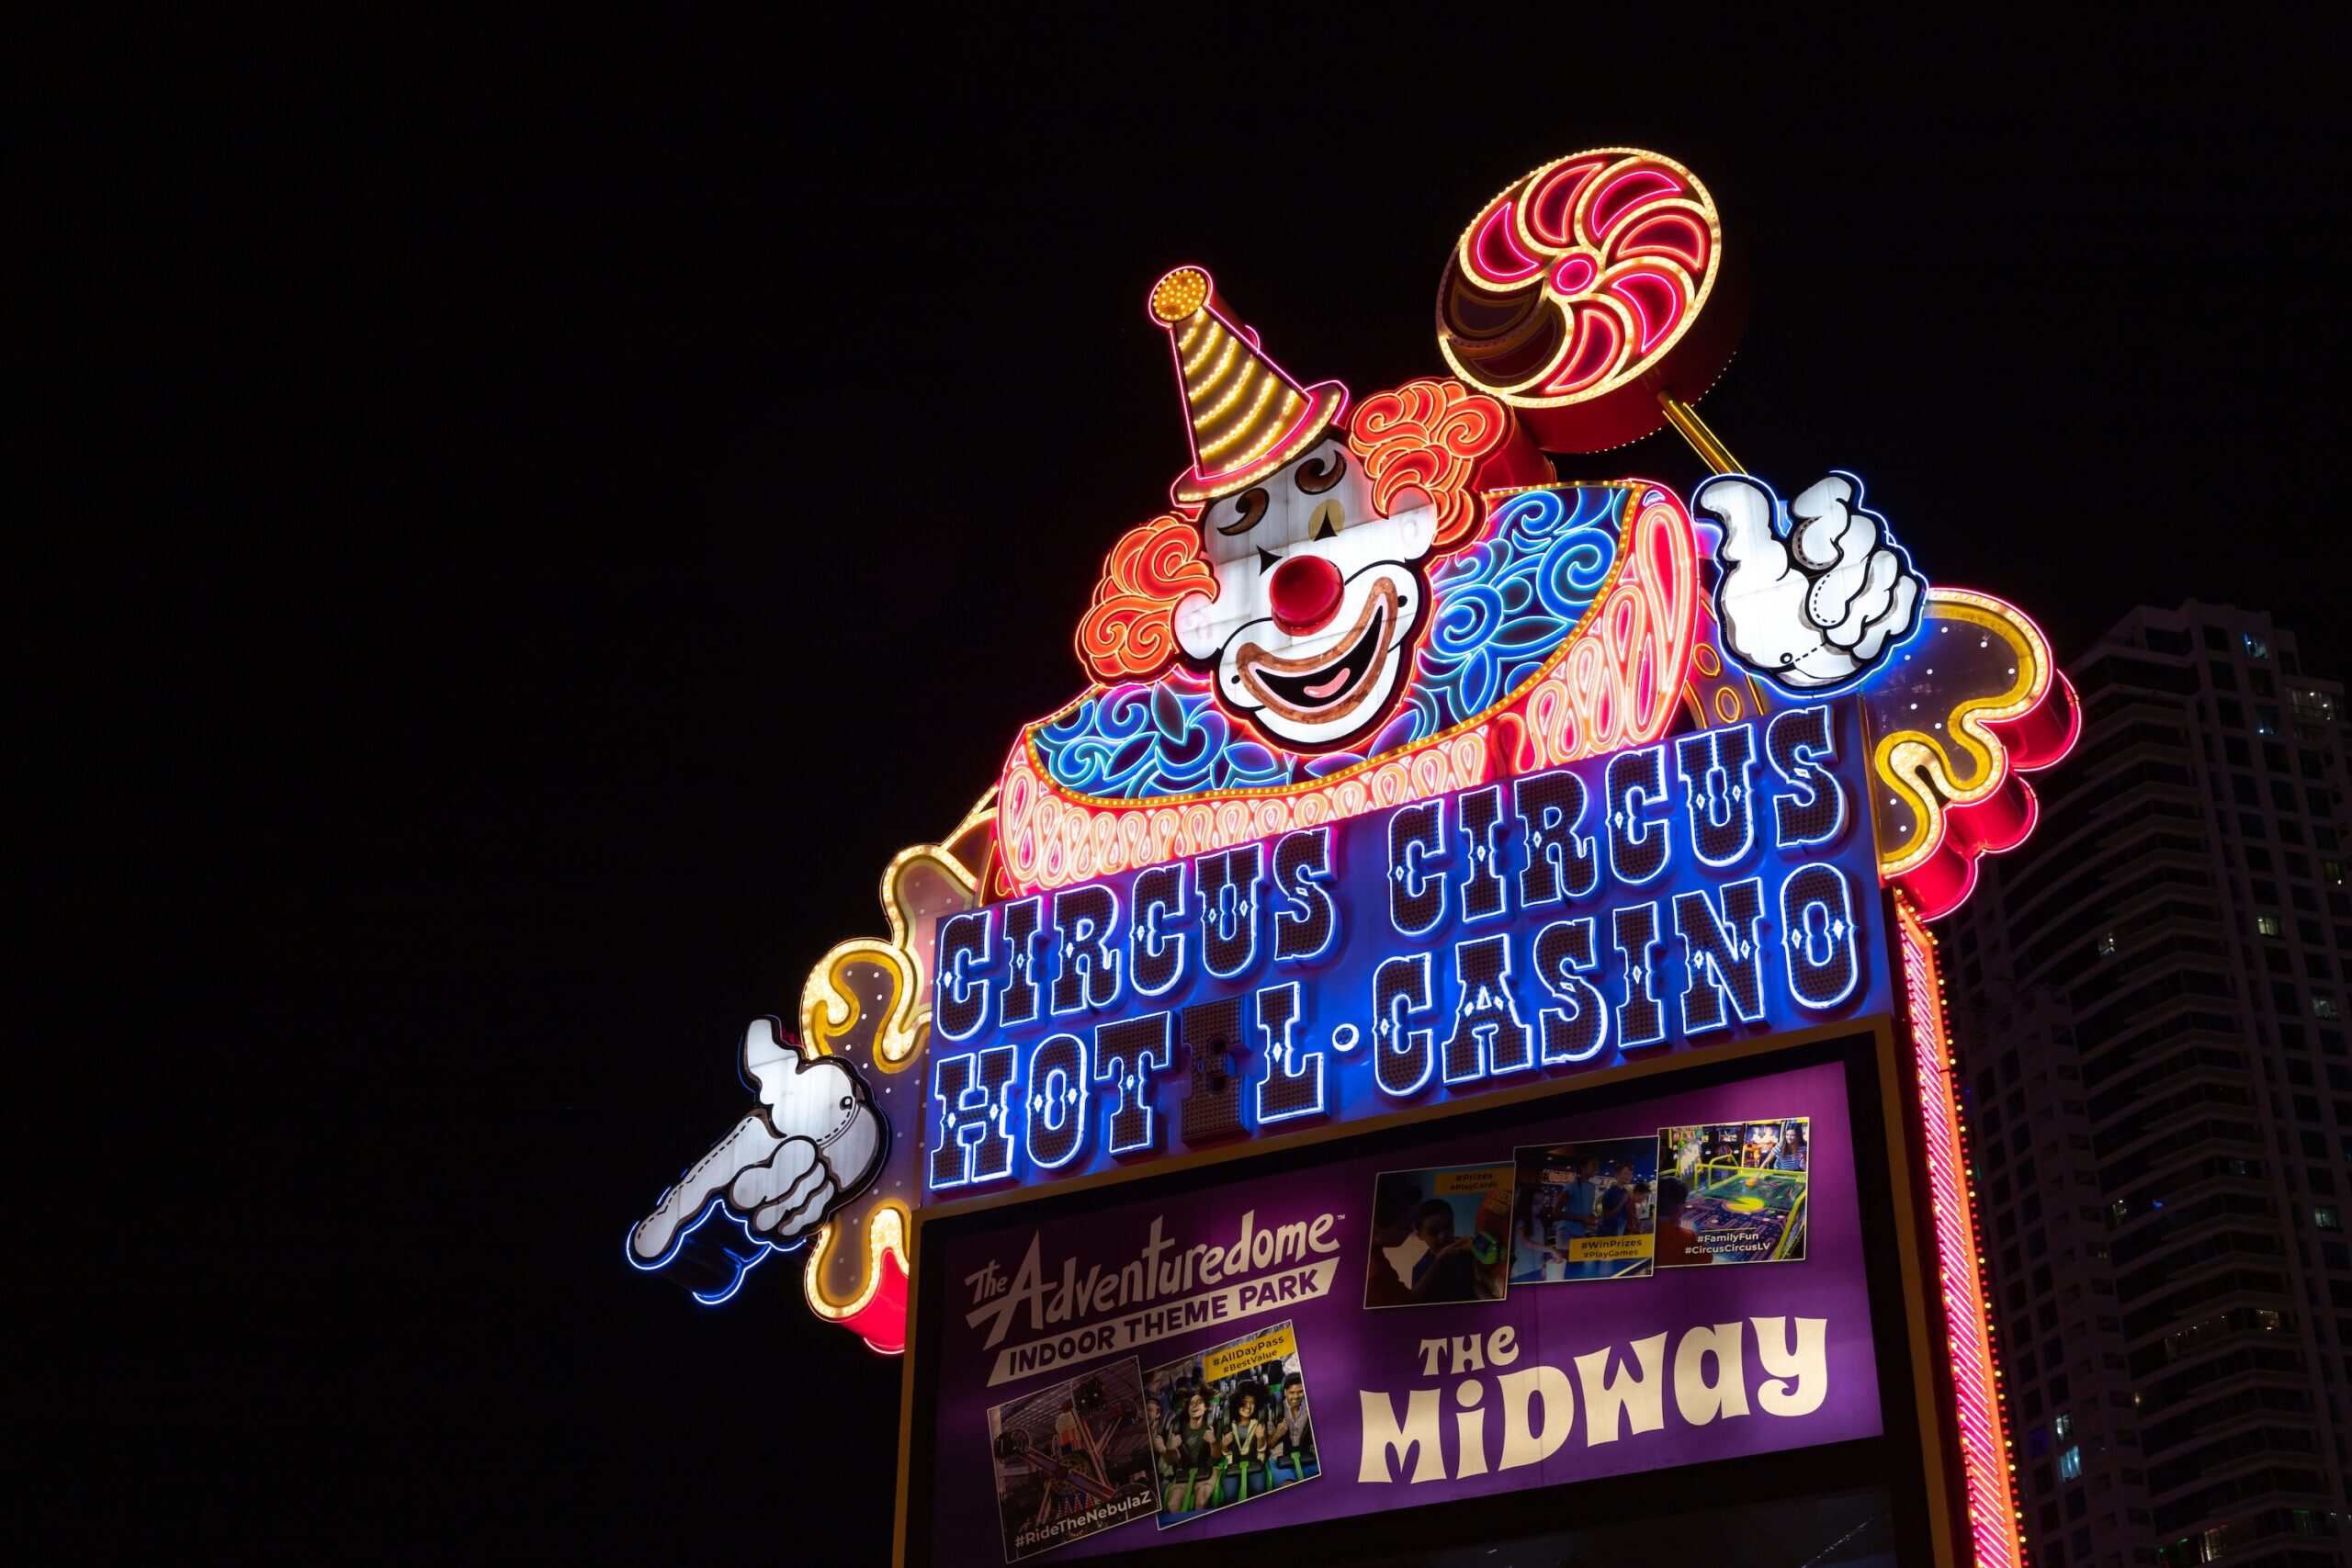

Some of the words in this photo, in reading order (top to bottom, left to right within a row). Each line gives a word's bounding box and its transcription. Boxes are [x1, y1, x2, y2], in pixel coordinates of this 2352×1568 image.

[936, 825, 1338, 1042] CIRCUS
[1388, 705, 1845, 936] CIRCUS
[929, 980, 1326, 1190] HOTEL
[1372, 862, 1860, 1097] CASINO
[1580, 1238, 1642, 1250] #WinPrizes
[1583, 1248, 1639, 1259] #PlayGames
[1684, 1242, 1771, 1256] #CircusCircusLV
[1697, 1232, 1759, 1244] #FamilyFun
[964, 1258, 1007, 1304] The
[965, 1209, 1340, 1352] Adventuredome
[1009, 1325, 1114, 1377] INDOOR
[1124, 1294, 1228, 1343] THEME
[1238, 1268, 1318, 1312] PARK
[1213, 1336, 1284, 1367] #AllDayPass
[1223, 1349, 1278, 1373] #BestValue
[1014, 1490, 1152, 1549] #RideTheNebulaZ
